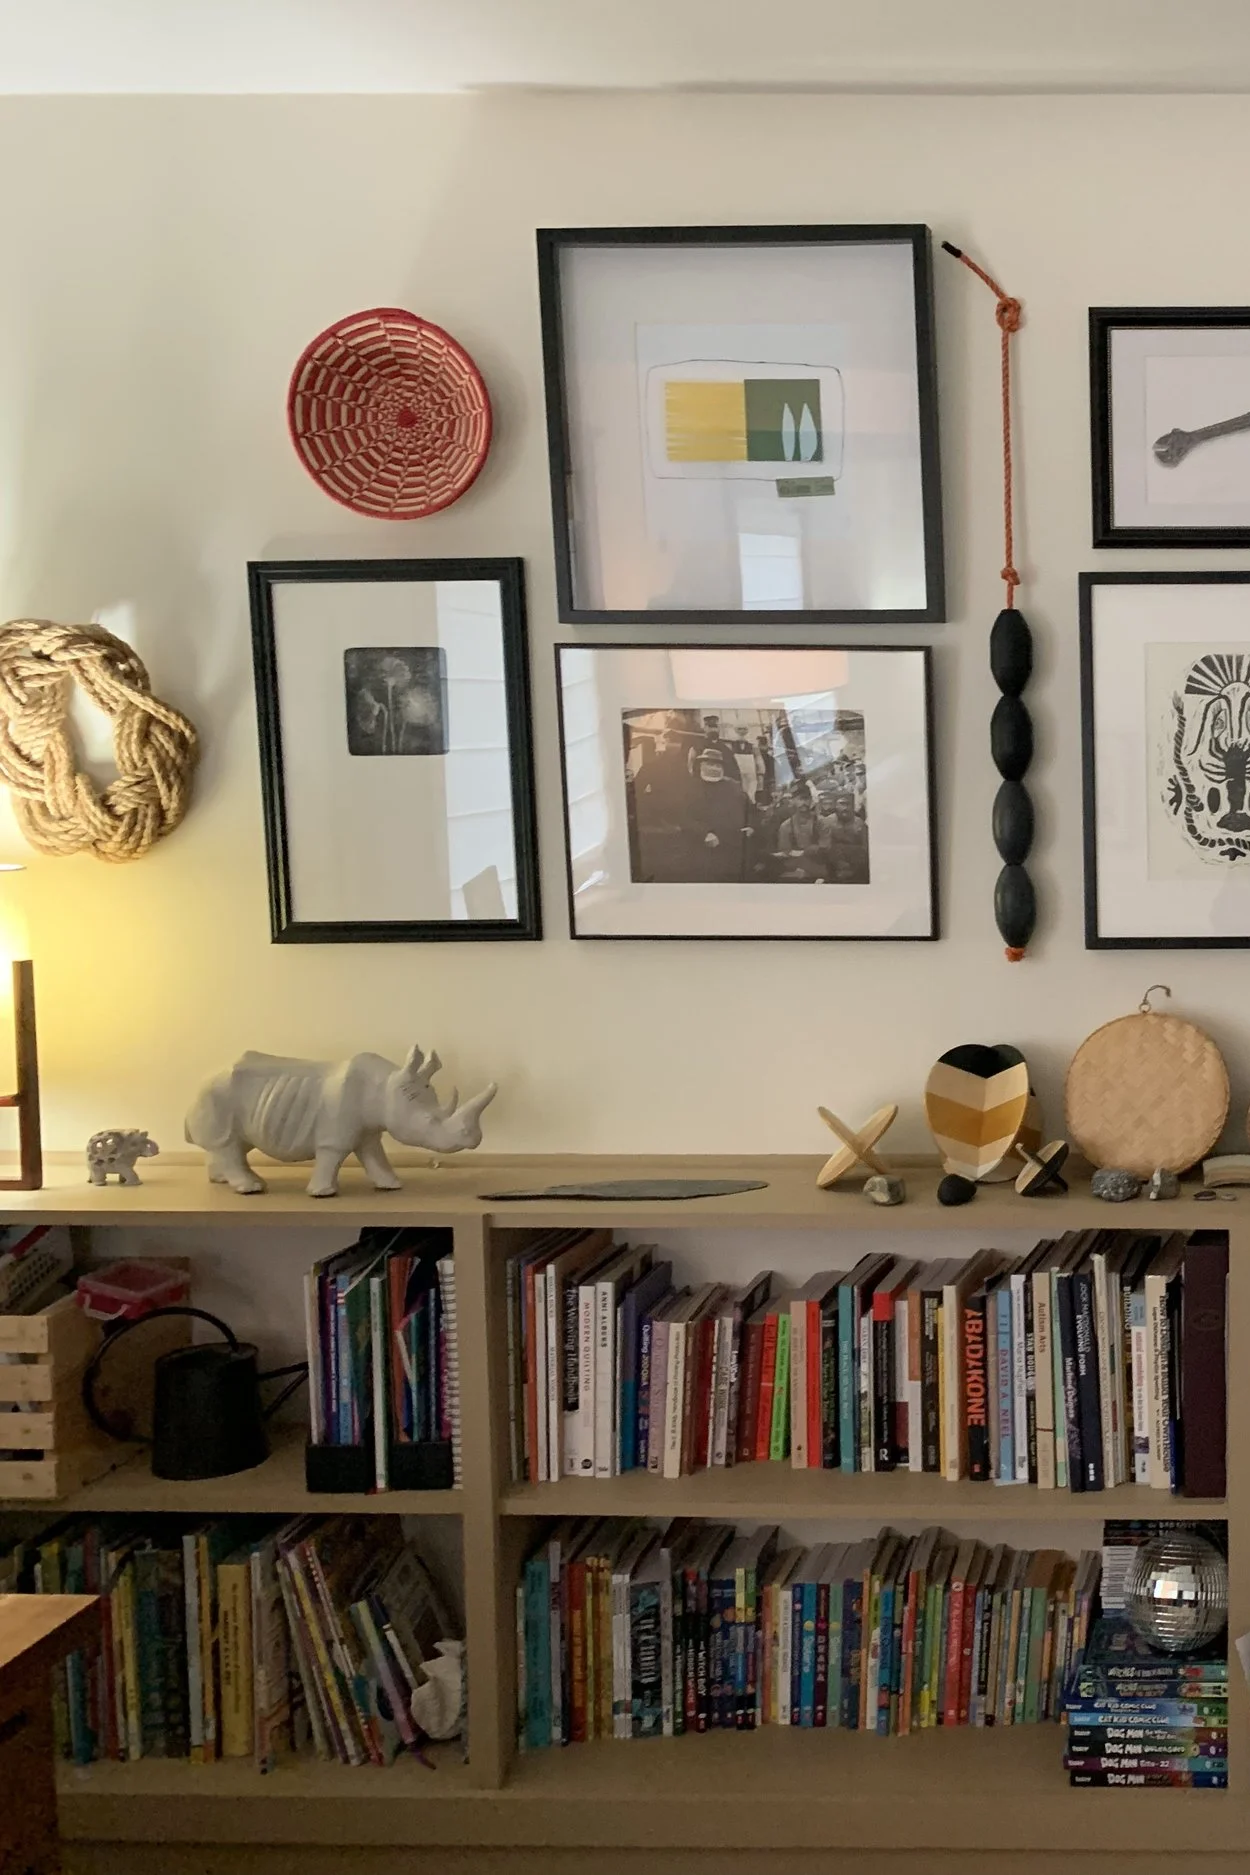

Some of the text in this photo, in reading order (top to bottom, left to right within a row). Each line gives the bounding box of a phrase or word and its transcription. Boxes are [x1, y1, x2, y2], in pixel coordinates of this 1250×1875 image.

[600, 1291, 608, 1312] ANNI
[1079, 1282, 1091, 1353] JOCK MACDONALD
[1122, 1286, 1132, 1330] BUILDING
[1159, 1295, 1169, 1317] How
[565, 1288, 578, 1405] The Weaving Handbook
[582, 1302, 591, 1392] MODERN QUILTING
[641, 1324, 651, 1353] Quilting
[1037, 1302, 1047, 1353] Autism Arts
[1075, 1314, 1087, 1376] EVOLVING FORM
[1026, 1332, 1035, 1391] STAN DOUGLAS
[1000, 1349, 1010, 1440] DAVID NEEL
[1064, 1357, 1076, 1419] Marlene Dumas
[1161, 1399, 1170, 1419] Your
[1161, 1419, 1170, 1442] Own
[697, 1651, 707, 1696] WITCH BOY
[817, 1634, 827, 1682] DRAMA
[1104, 1743, 1124, 1754] DOG
[1124, 1743, 1143, 1754] MAN
[1106, 1727, 1144, 1739] DOG MAN
[1100, 1757, 1138, 1769] DOG MAN
[1107, 1773, 1145, 1785] DOG MAN
